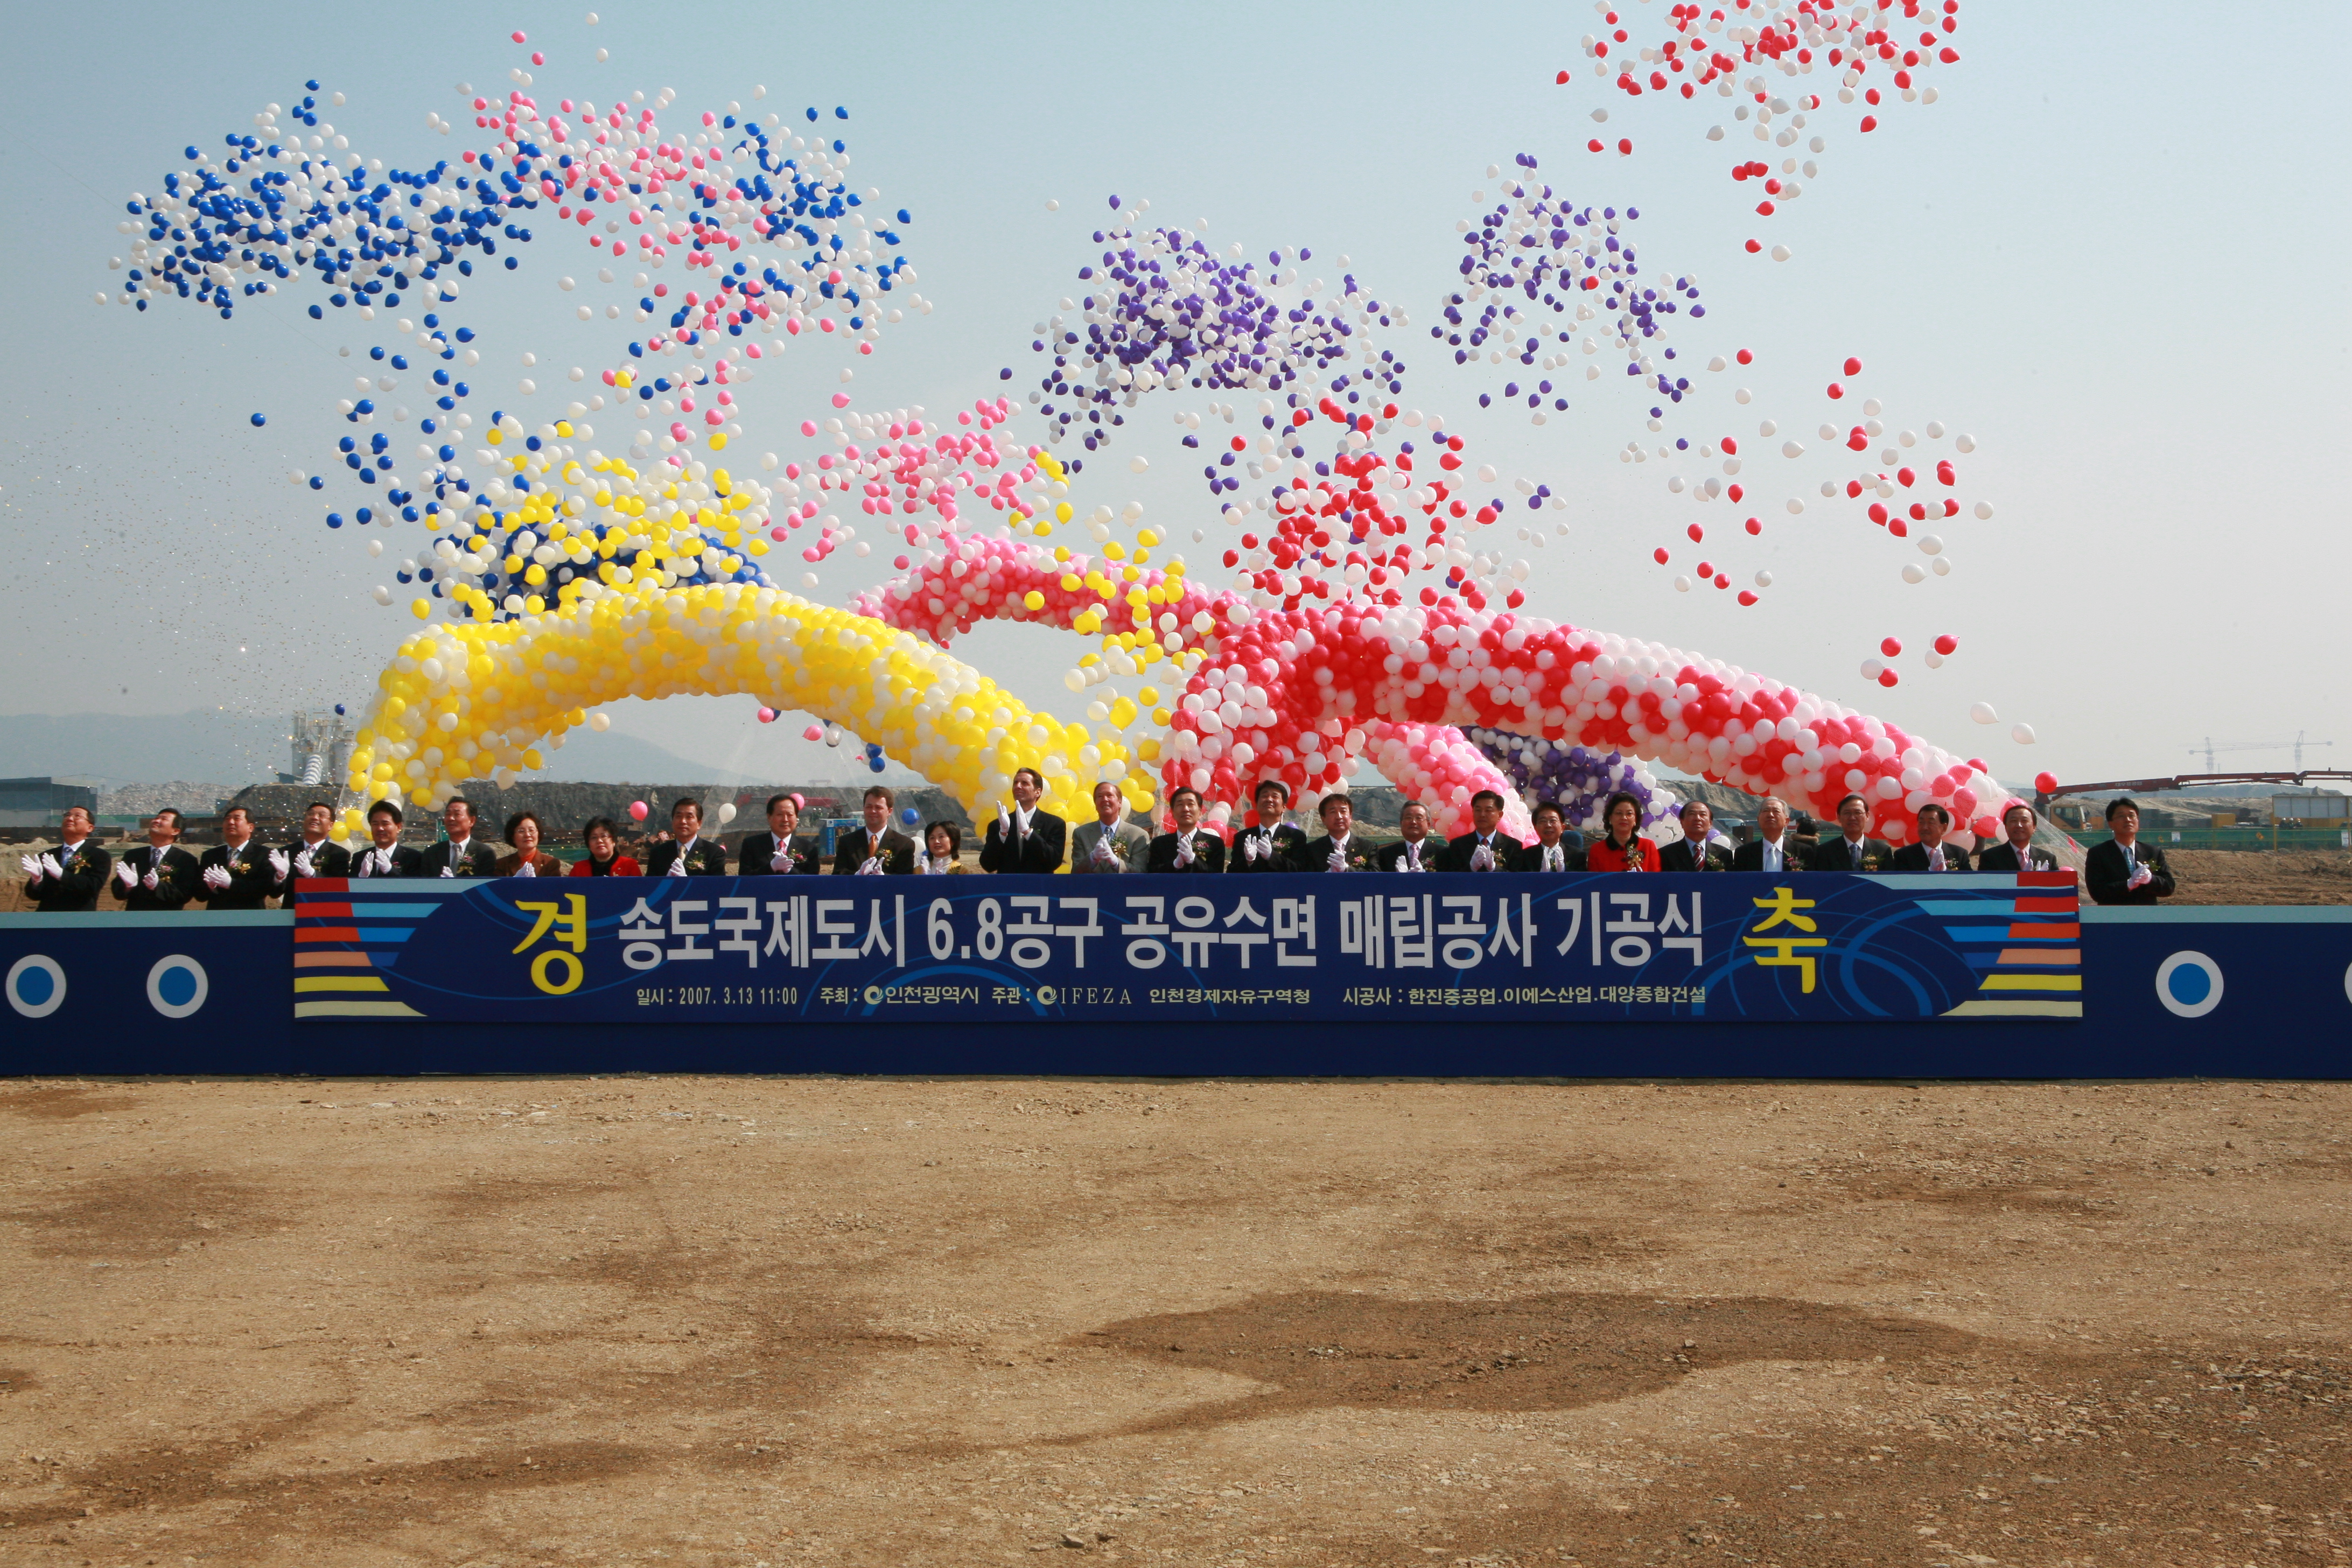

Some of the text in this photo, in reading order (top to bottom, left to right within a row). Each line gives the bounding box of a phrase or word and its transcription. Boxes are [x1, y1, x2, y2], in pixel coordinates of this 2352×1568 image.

[512, 893, 586, 995] 경
[619, 892, 1703, 970] 송도국제도시 6.8공구 공유수면 매립공사 기공식
[1742, 887, 1828, 993] 축
[760, 987, 797, 1005] 11:00
[885, 986, 978, 1004] 인천광역시
[1061, 988, 1132, 1004] IFEZA
[1150, 988, 1310, 1004] 인천경제자유구역청
